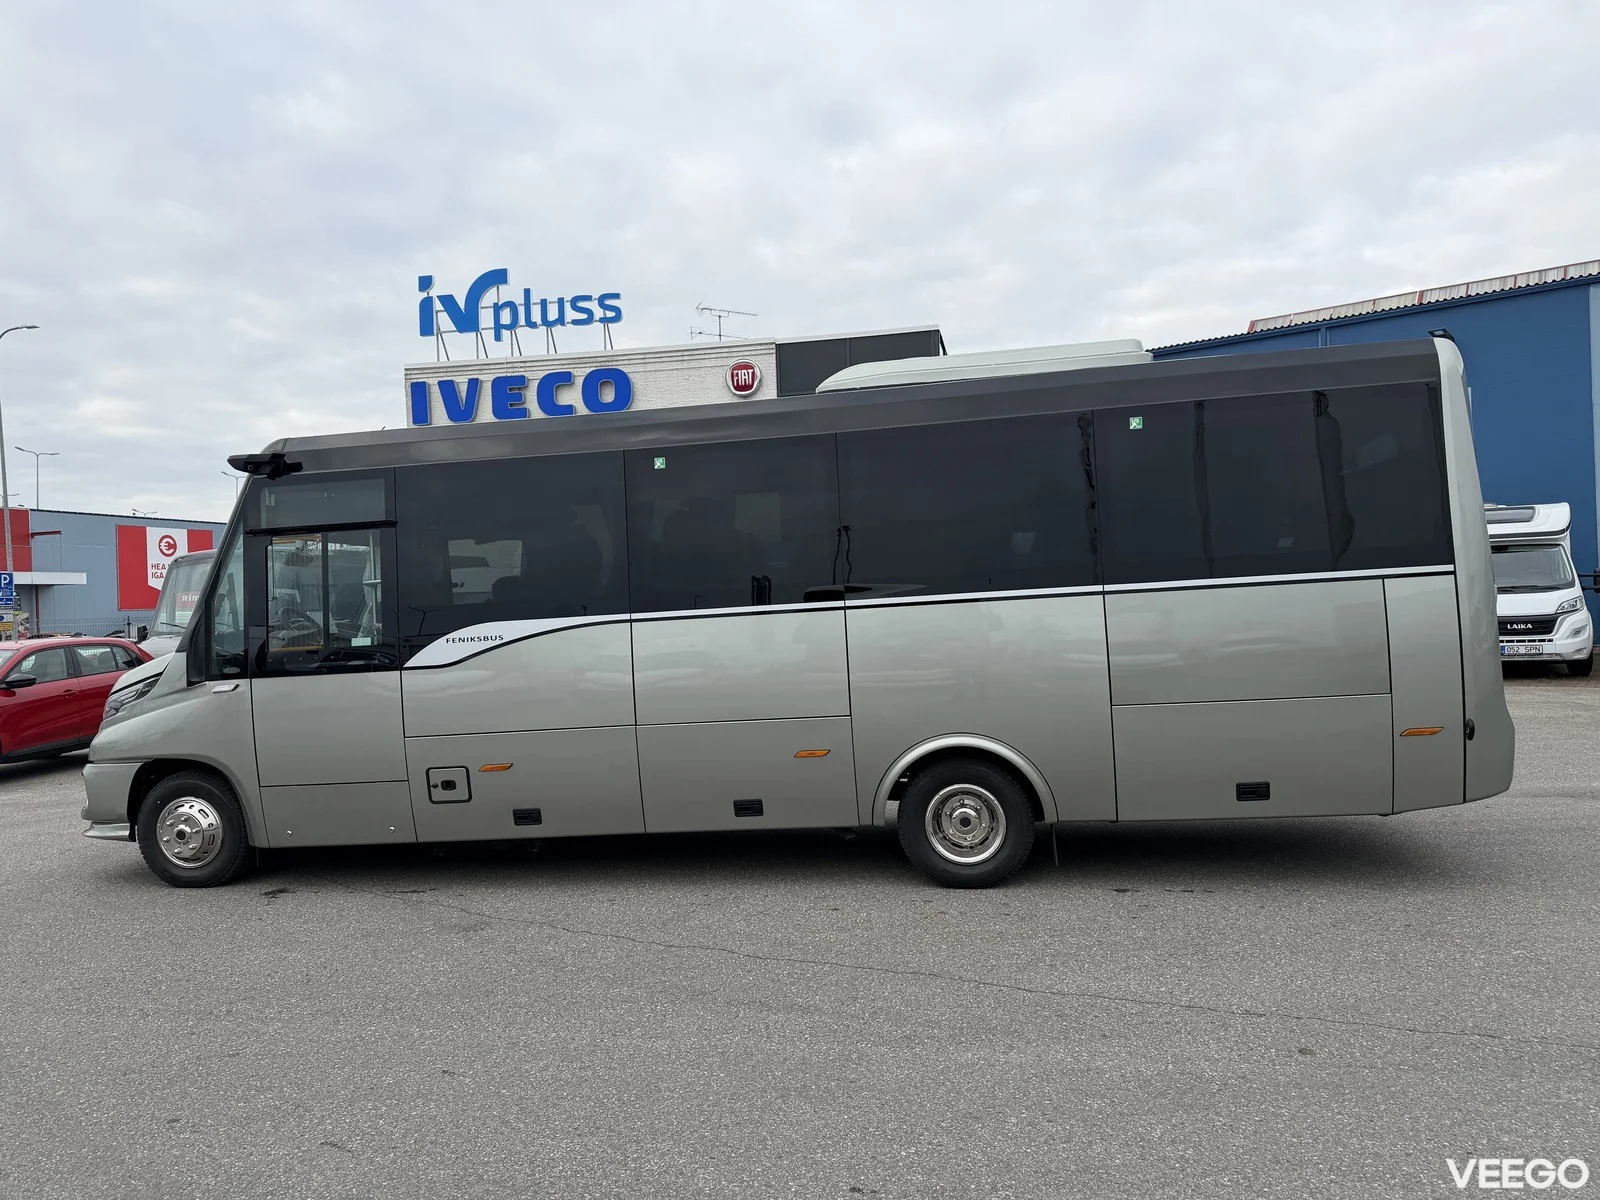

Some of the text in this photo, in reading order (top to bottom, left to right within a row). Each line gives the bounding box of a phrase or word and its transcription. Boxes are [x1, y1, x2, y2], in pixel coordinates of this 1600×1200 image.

[733, 369, 754, 387] FIAT
[410, 368, 632, 426] IVECO
[151, 563, 167, 571] HEA
[151, 571, 165, 580] IGA
[1, 574, 10, 588] P
[445, 634, 505, 644] FENIKSBUS
[1524, 645, 1541, 653] SPN
